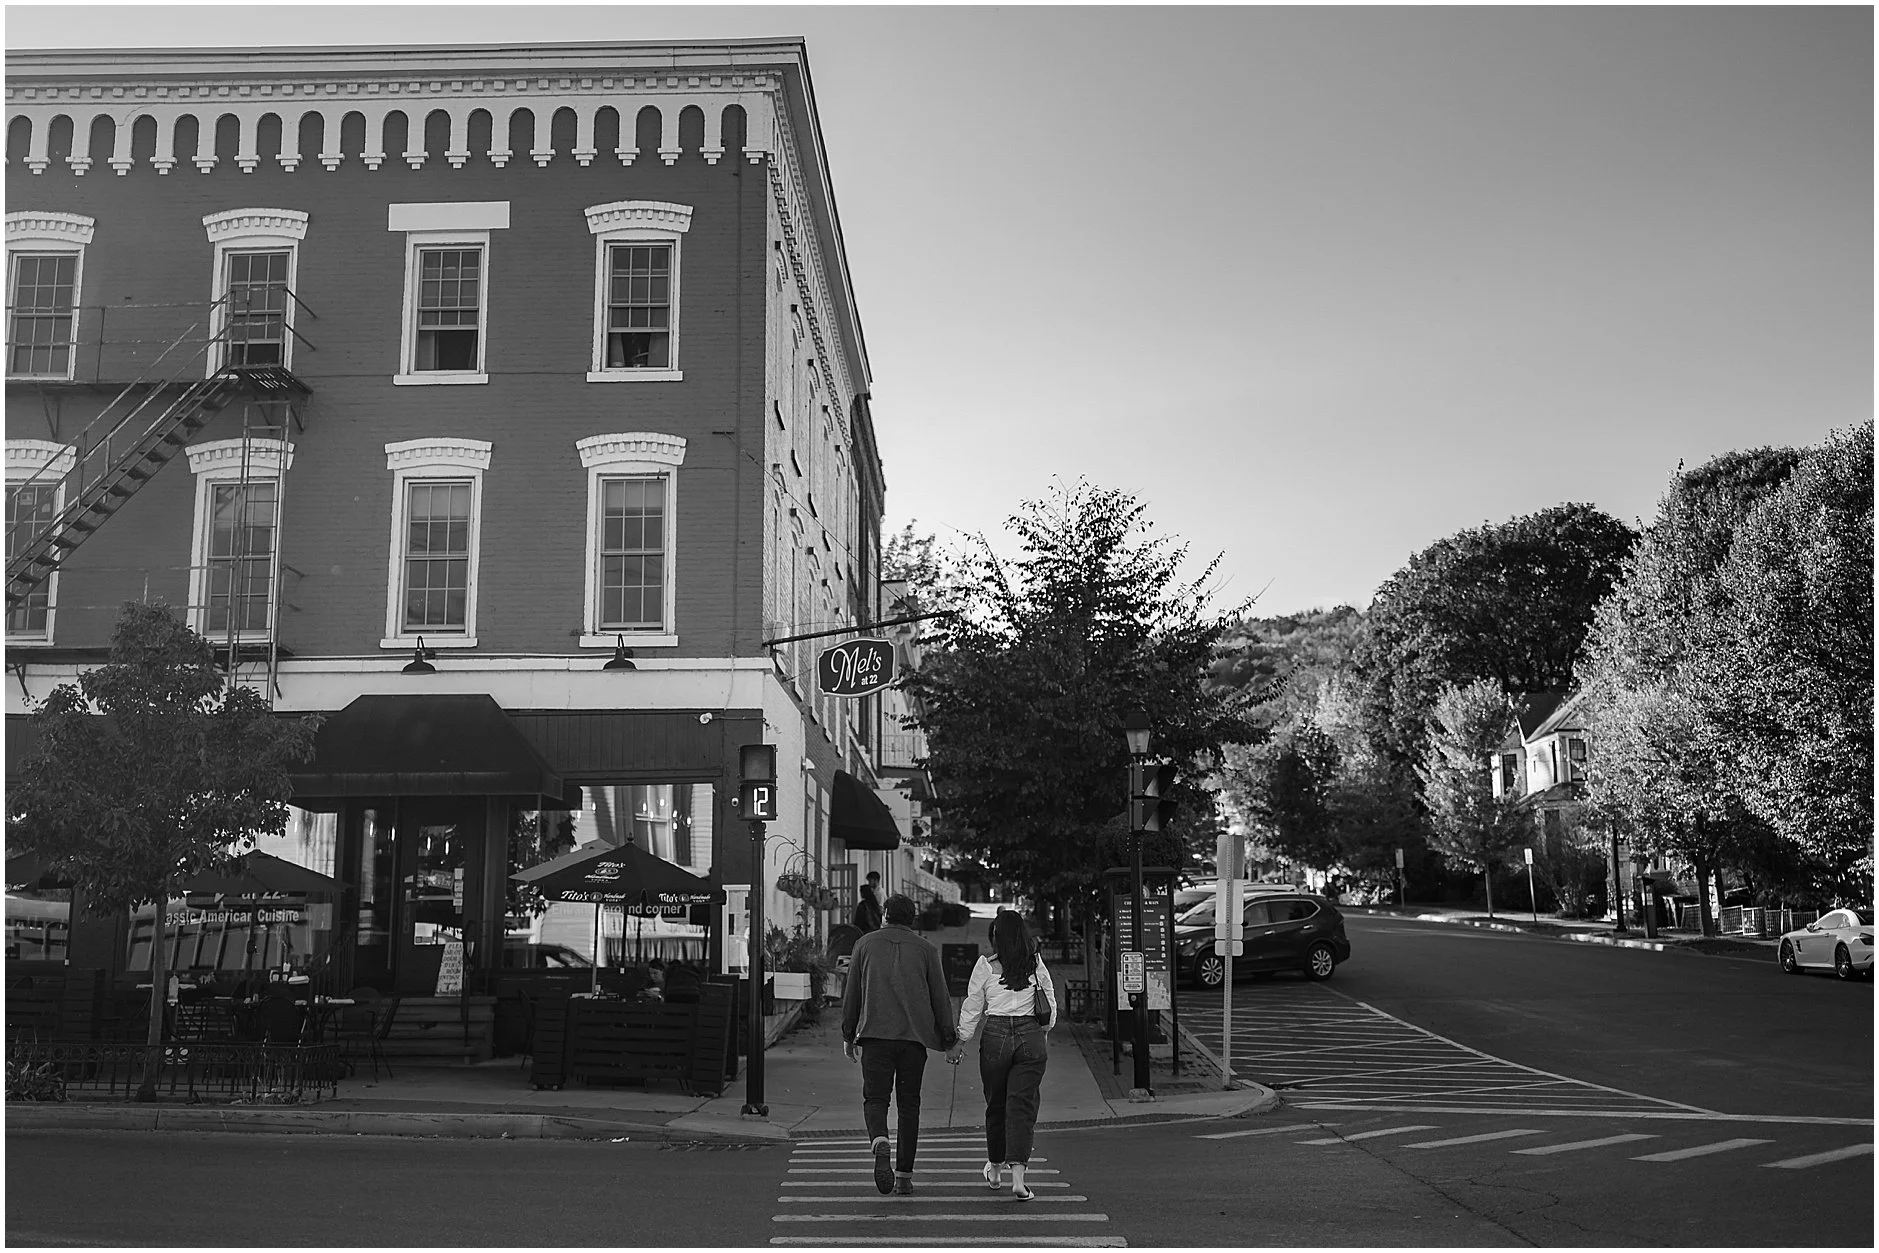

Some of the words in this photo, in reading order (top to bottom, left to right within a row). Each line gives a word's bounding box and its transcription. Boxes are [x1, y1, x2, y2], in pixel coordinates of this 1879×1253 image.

[830, 646, 882, 692] Mel's
[861, 676, 868, 686] at
[869, 674, 878, 685] 22
[753, 787, 769, 816] 12
[560, 890, 589, 901] Tito's
[658, 893, 678, 903] Tito's
[165, 910, 196, 922] assic
[257, 909, 299, 923] Cuisine
[645, 905, 682, 915] corner
